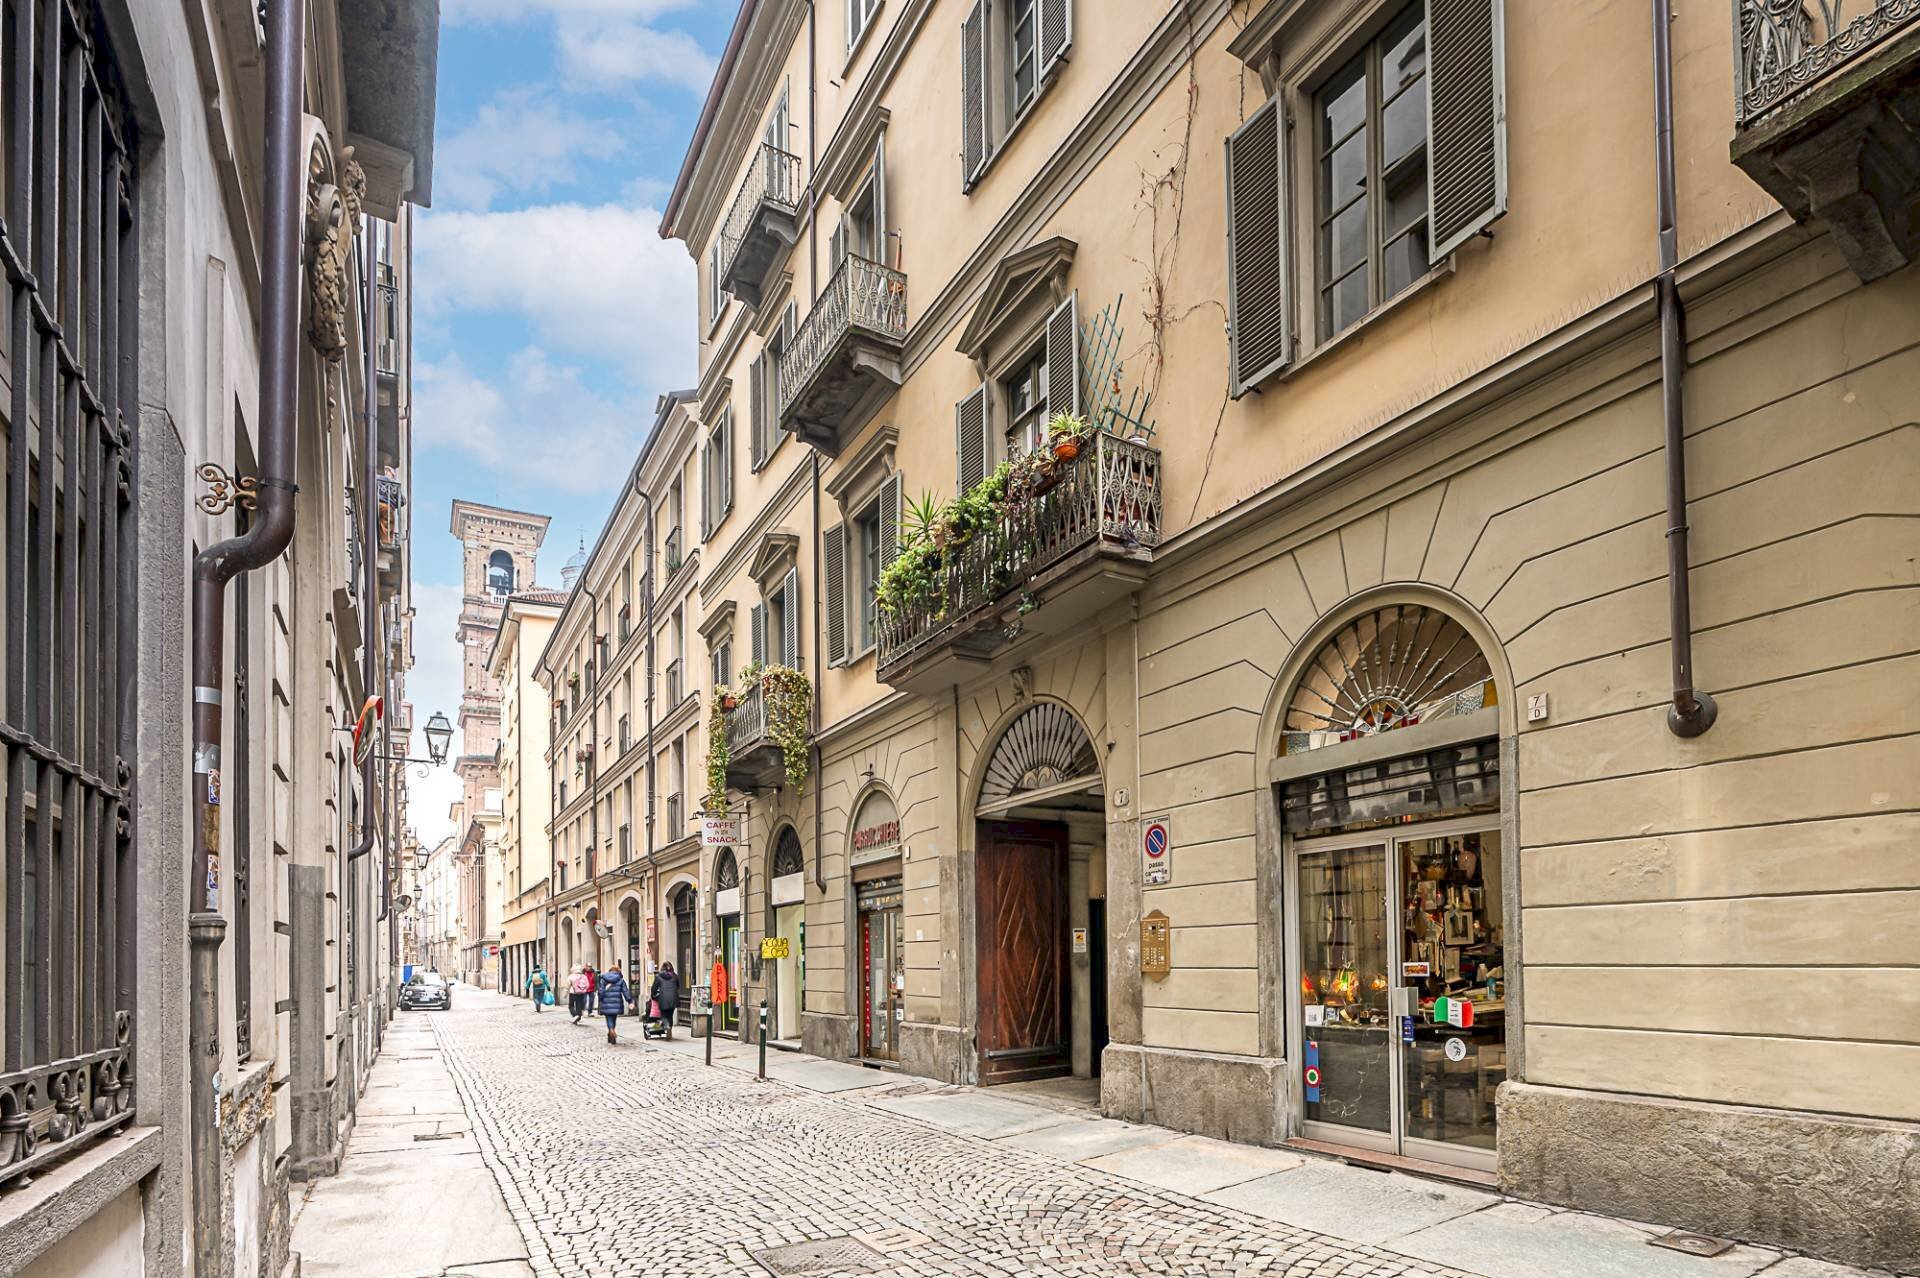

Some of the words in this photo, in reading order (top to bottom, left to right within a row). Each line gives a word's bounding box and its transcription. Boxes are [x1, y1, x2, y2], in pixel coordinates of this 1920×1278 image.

[1534, 695, 1540, 707] 7
[1534, 709, 1540, 718] D
[707, 836, 738, 844] SNACK
[1148, 861, 1164, 870] passo
[761, 937, 788, 948] ACQUA
